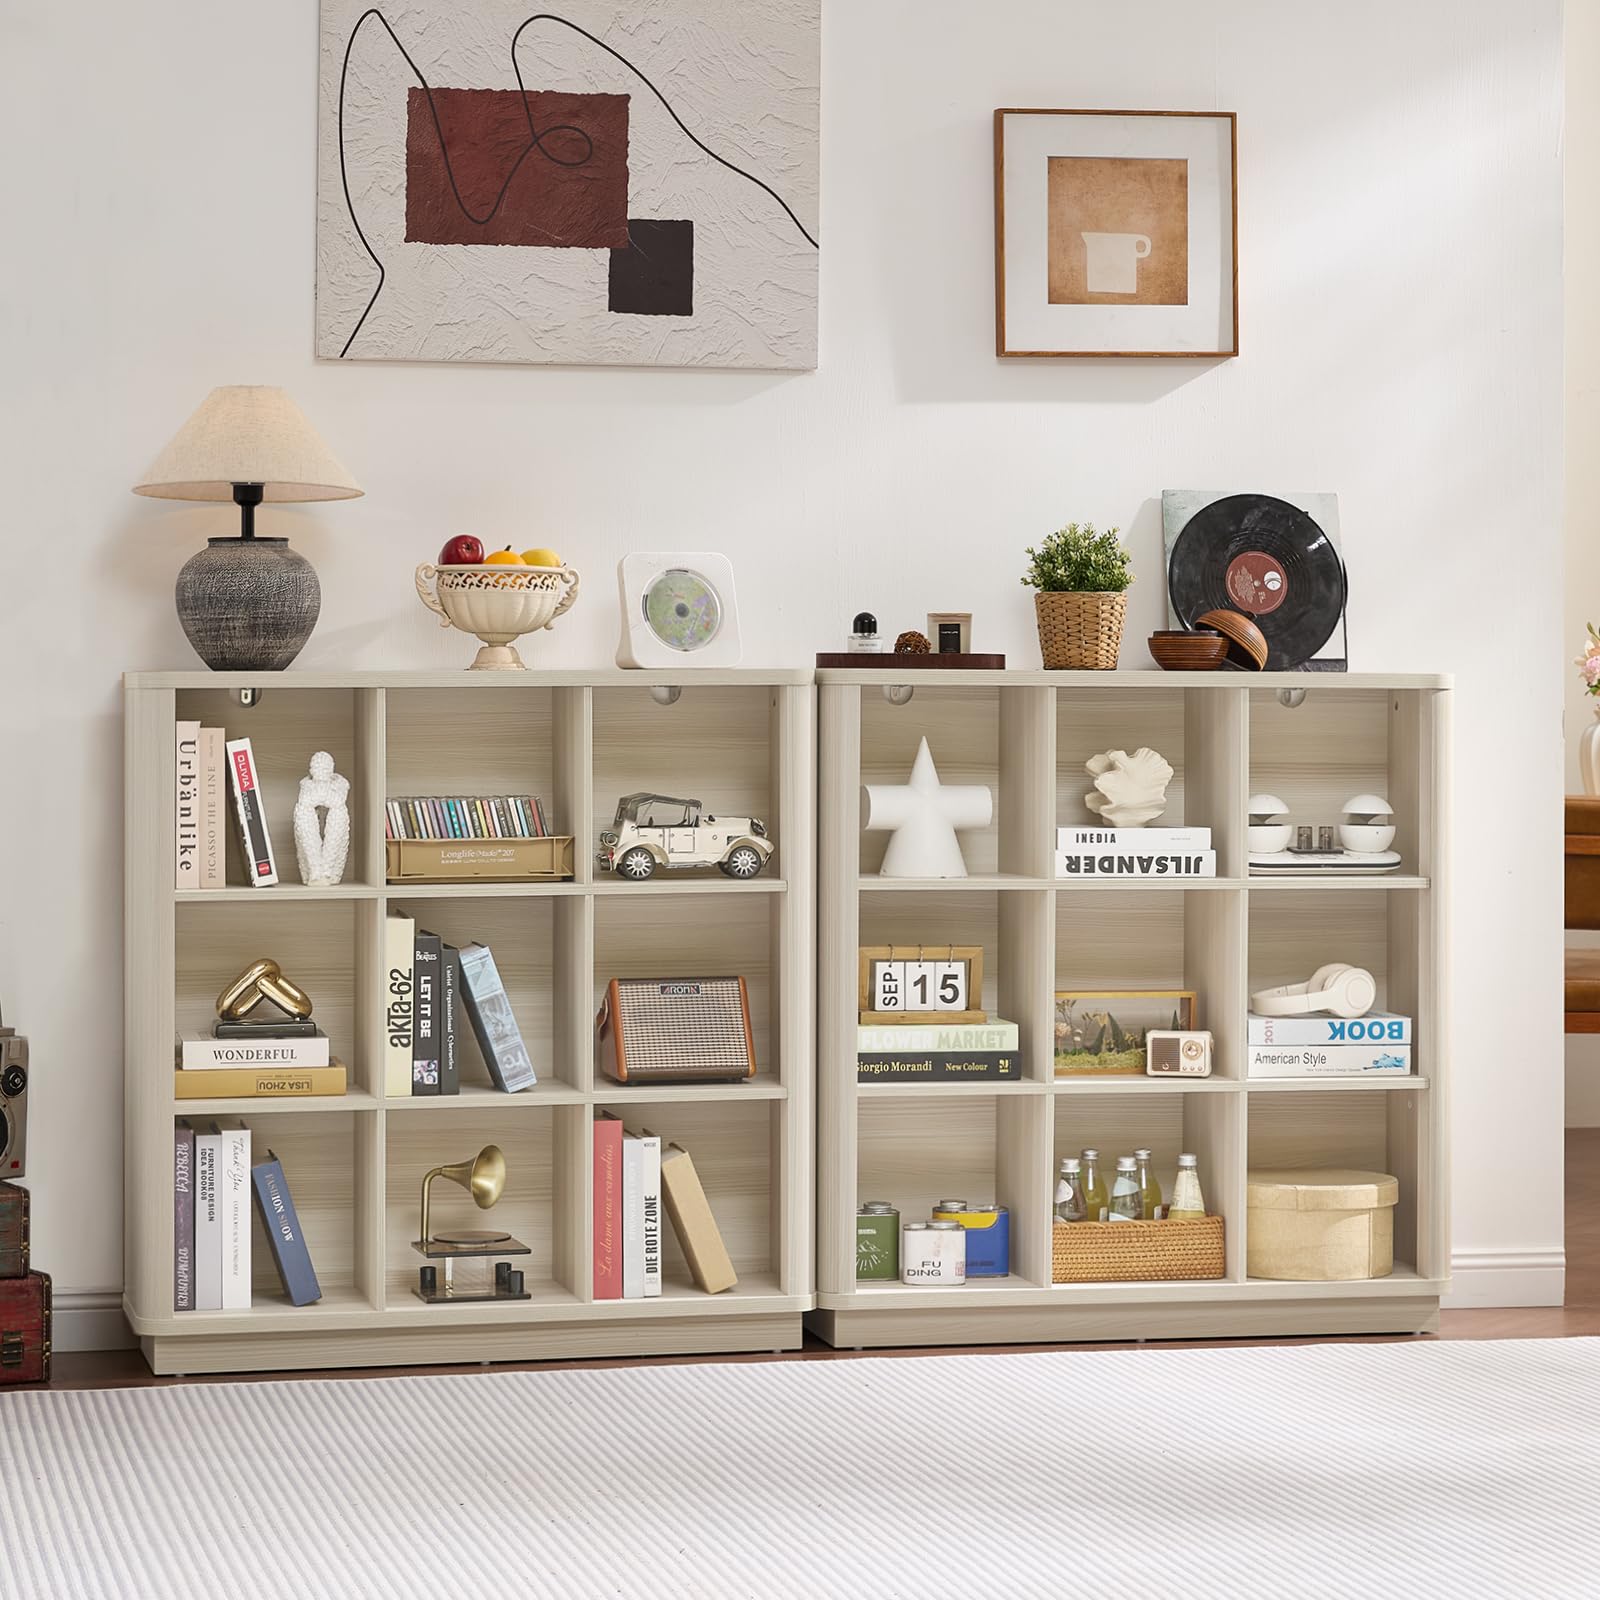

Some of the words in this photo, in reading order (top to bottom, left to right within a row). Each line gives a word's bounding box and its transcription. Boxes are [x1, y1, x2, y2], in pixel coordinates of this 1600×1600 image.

[208, 766, 216, 795] LINE
[237, 754, 250, 789] OLIVIA
[180, 740, 197, 871] Urbänlike
[208, 801, 216, 822] THE
[1076, 833, 1116, 843] INEDIA
[208, 830, 216, 879] PICASSO
[420, 976, 431, 1002] LET
[882, 972, 898, 1006] SEP
[420, 1004, 431, 1016] IT
[420, 1020, 431, 1038] BE
[1328, 1021, 1403, 1041] BOOK
[862, 1031, 933, 1049] FLOWER
[937, 1030, 1007, 1049] MARKET
[213, 1049, 297, 1061] WONDERFUL
[1255, 1053, 1300, 1064] American
[1302, 1052, 1327, 1067] Style
[890, 1061, 932, 1072] Morandi
[945, 1063, 961, 1071] New
[963, 1062, 988, 1071] Colour
[259, 1081, 286, 1091] ZHOU
[288, 1081, 309, 1090] LISA
[265, 1173, 284, 1214] FASHION
[278, 1214, 294, 1242] SHOW
[644, 1195, 657, 1224] ZONE
[645, 1226, 658, 1256] ROTE
[645, 1256, 658, 1274] DIE
[907, 1269, 942, 1277] DING
